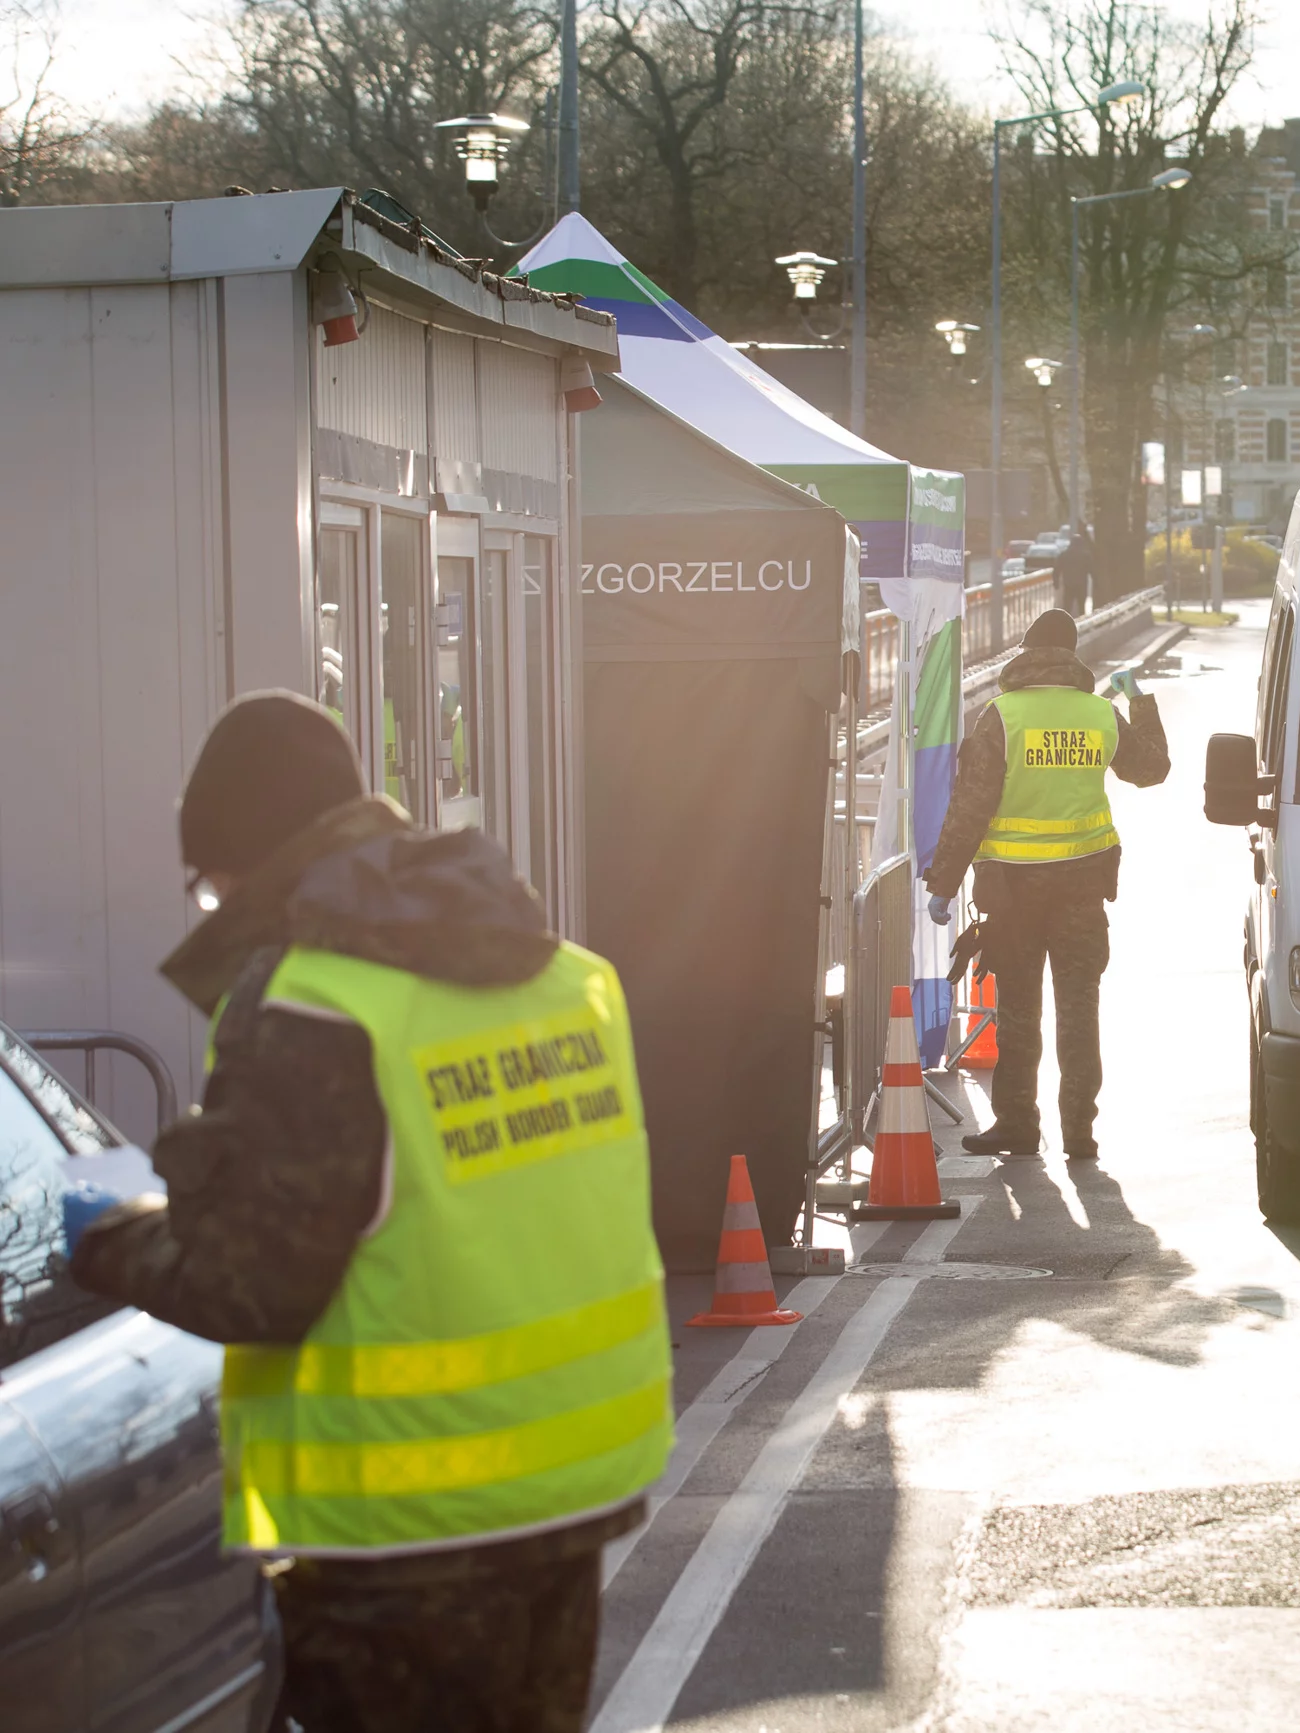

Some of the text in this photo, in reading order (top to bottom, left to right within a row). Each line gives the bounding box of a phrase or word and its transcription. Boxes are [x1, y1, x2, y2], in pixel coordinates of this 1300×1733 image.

[1026, 748, 1102, 766] GRANICZNA
[1043, 731, 1086, 748] STRAŻ
[498, 1029, 609, 1091] GRANICZNA
[441, 1085, 624, 1162] POLISH BORDER GUARD
